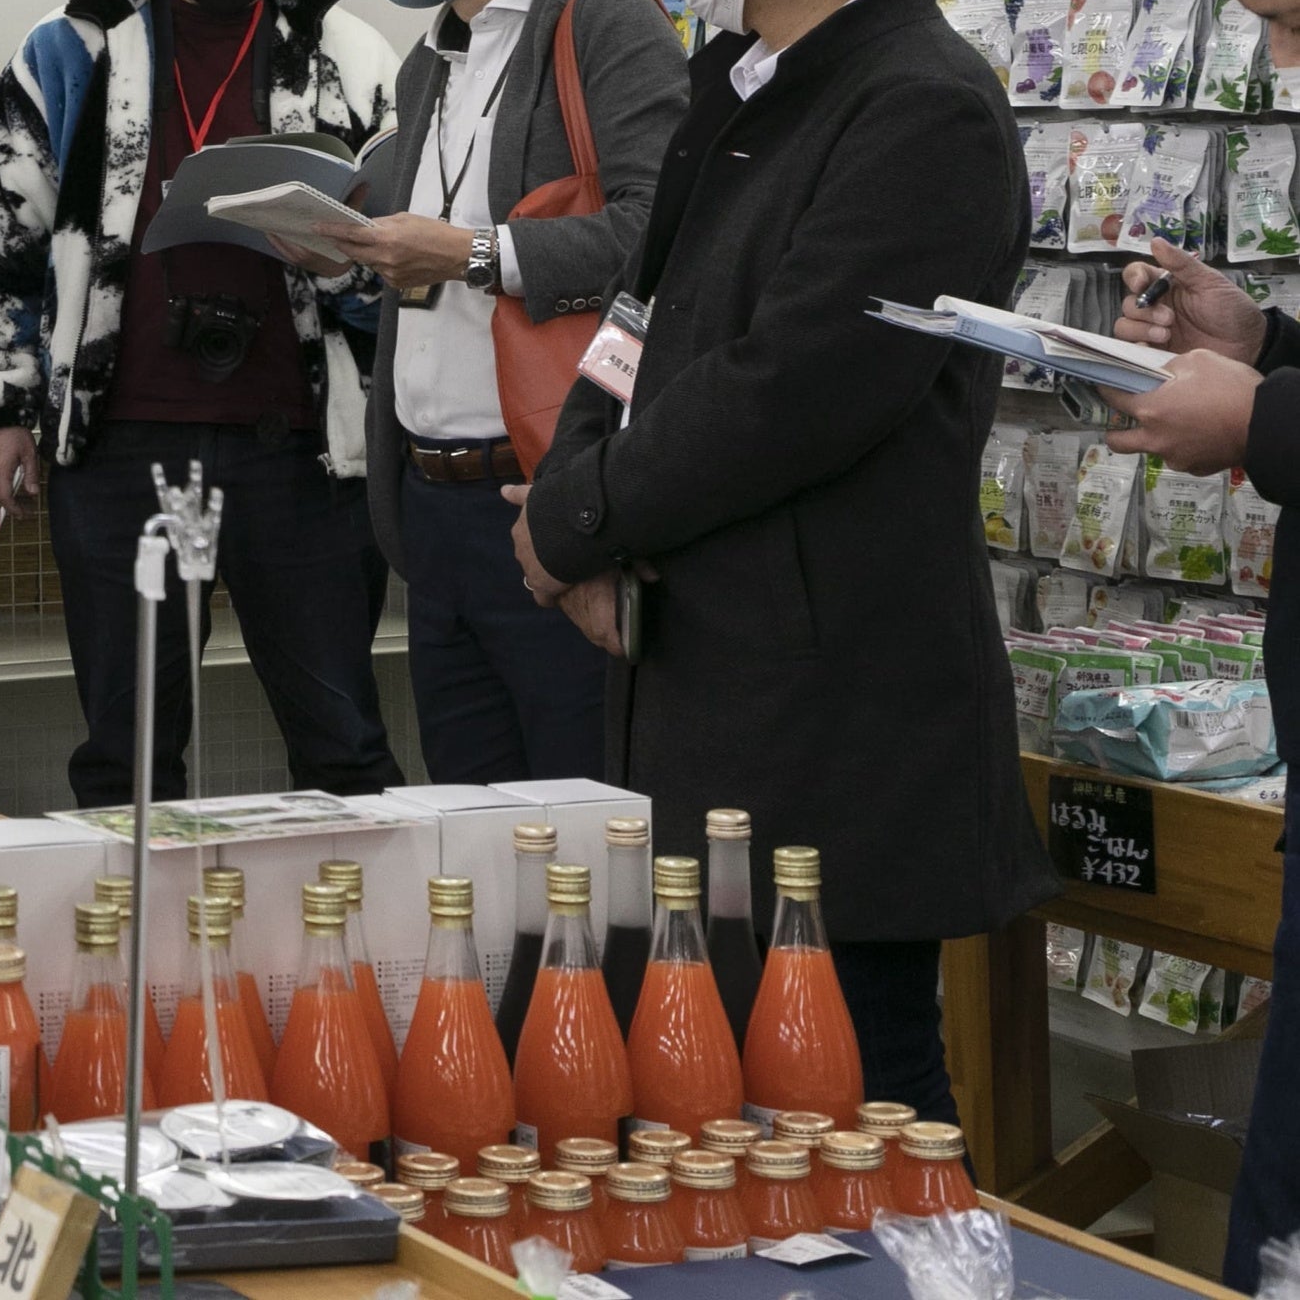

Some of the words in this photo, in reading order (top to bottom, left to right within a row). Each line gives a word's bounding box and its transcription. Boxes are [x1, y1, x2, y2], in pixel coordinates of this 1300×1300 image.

[1051, 803, 1107, 834] はるみ
[1087, 834, 1149, 861] ごはん
[1082, 857, 1142, 887] ¥432
